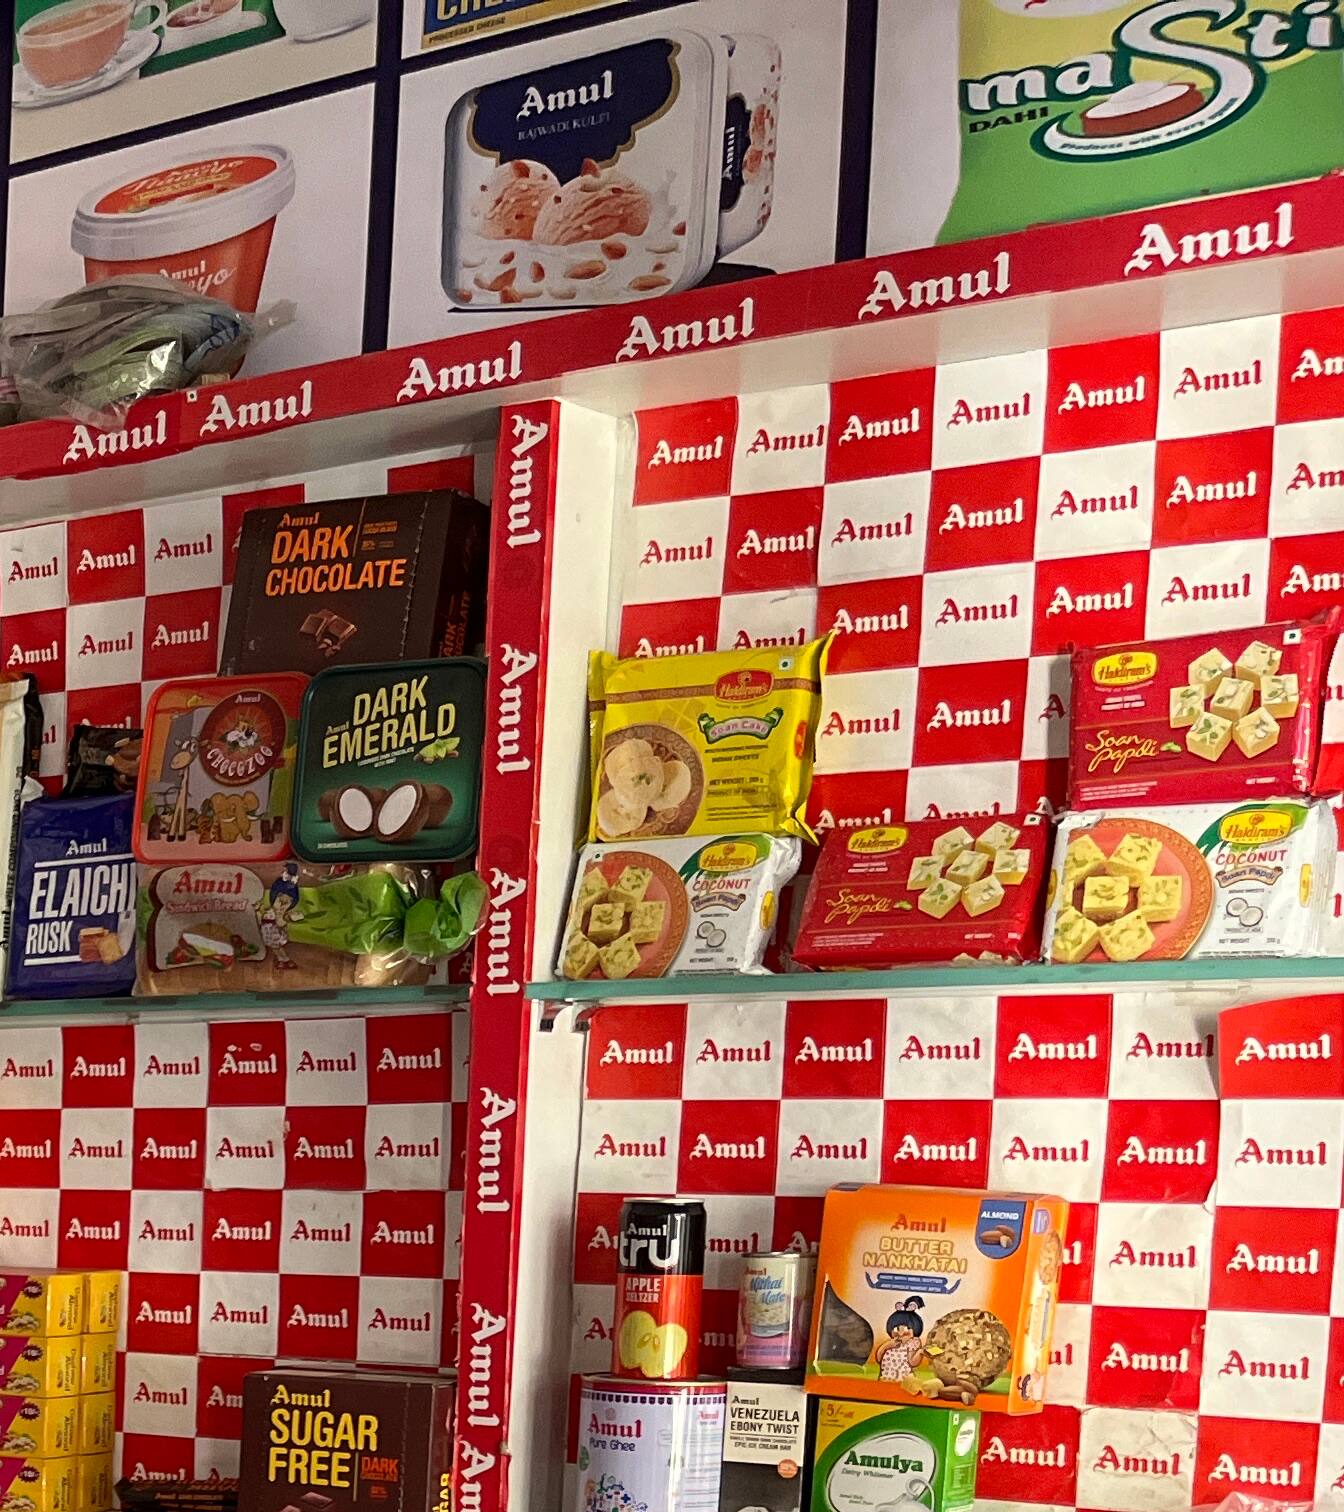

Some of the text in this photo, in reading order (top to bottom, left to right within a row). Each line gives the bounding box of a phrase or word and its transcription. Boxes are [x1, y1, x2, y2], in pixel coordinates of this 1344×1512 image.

[516, 70, 614, 121] Amul
[968, 106, 1049, 134] DAHI
[722, 126, 736, 181] Amul
[615, 297, 755, 364] Amul
[63, 411, 168, 465] Amul
[1165, 469, 1260, 509] Amul
[279, 511, 321, 530] Amul
[270, 524, 354, 564] DARK
[264, 558, 408, 597] CHOCOLATE
[933, 593, 1020, 631] Amul
[353, 675, 429, 727] DARK
[497, 642, 539, 776] Amul
[322, 702, 457, 770] EMERALD
[65, 837, 107, 856] Amul
[1215, 849, 1288, 866] COCONUT
[28, 862, 136, 921] ELAICHI
[172, 870, 245, 895] Amul
[692, 878, 752, 892] COCONUT
[25, 920, 74, 955] RUSK
[600, 1039, 675, 1071] Amul
[899, 1034, 983, 1065] Amul
[1235, 1032, 1333, 1066] Amul
[626, 1222, 668, 1236] Amul
[891, 1213, 947, 1233] Amul
[980, 1210, 1020, 1221] ALMOND
[879, 1236, 954, 1255] BUTTER
[863, 1251, 968, 1274] NANKHATAI
[626, 1277, 662, 1293] APPLE
[468, 1301, 508, 1430] Amul
[270, 1384, 331, 1409] Amul
[731, 1395, 760, 1406] Amul
[587, 1413, 643, 1439] Amul
[730, 1407, 800, 1423] VENEZUELA
[730, 1421, 800, 1435] EBONY TWIST
[268, 1408, 379, 1452] SUGAR
[589, 1437, 636, 1452] Pure Ghee
[267, 1447, 352, 1489] FREE
[360, 1456, 399, 1474] DARK
[844, 1450, 924, 1474] Amulya
[1208, 1453, 1303, 1488] Amul
